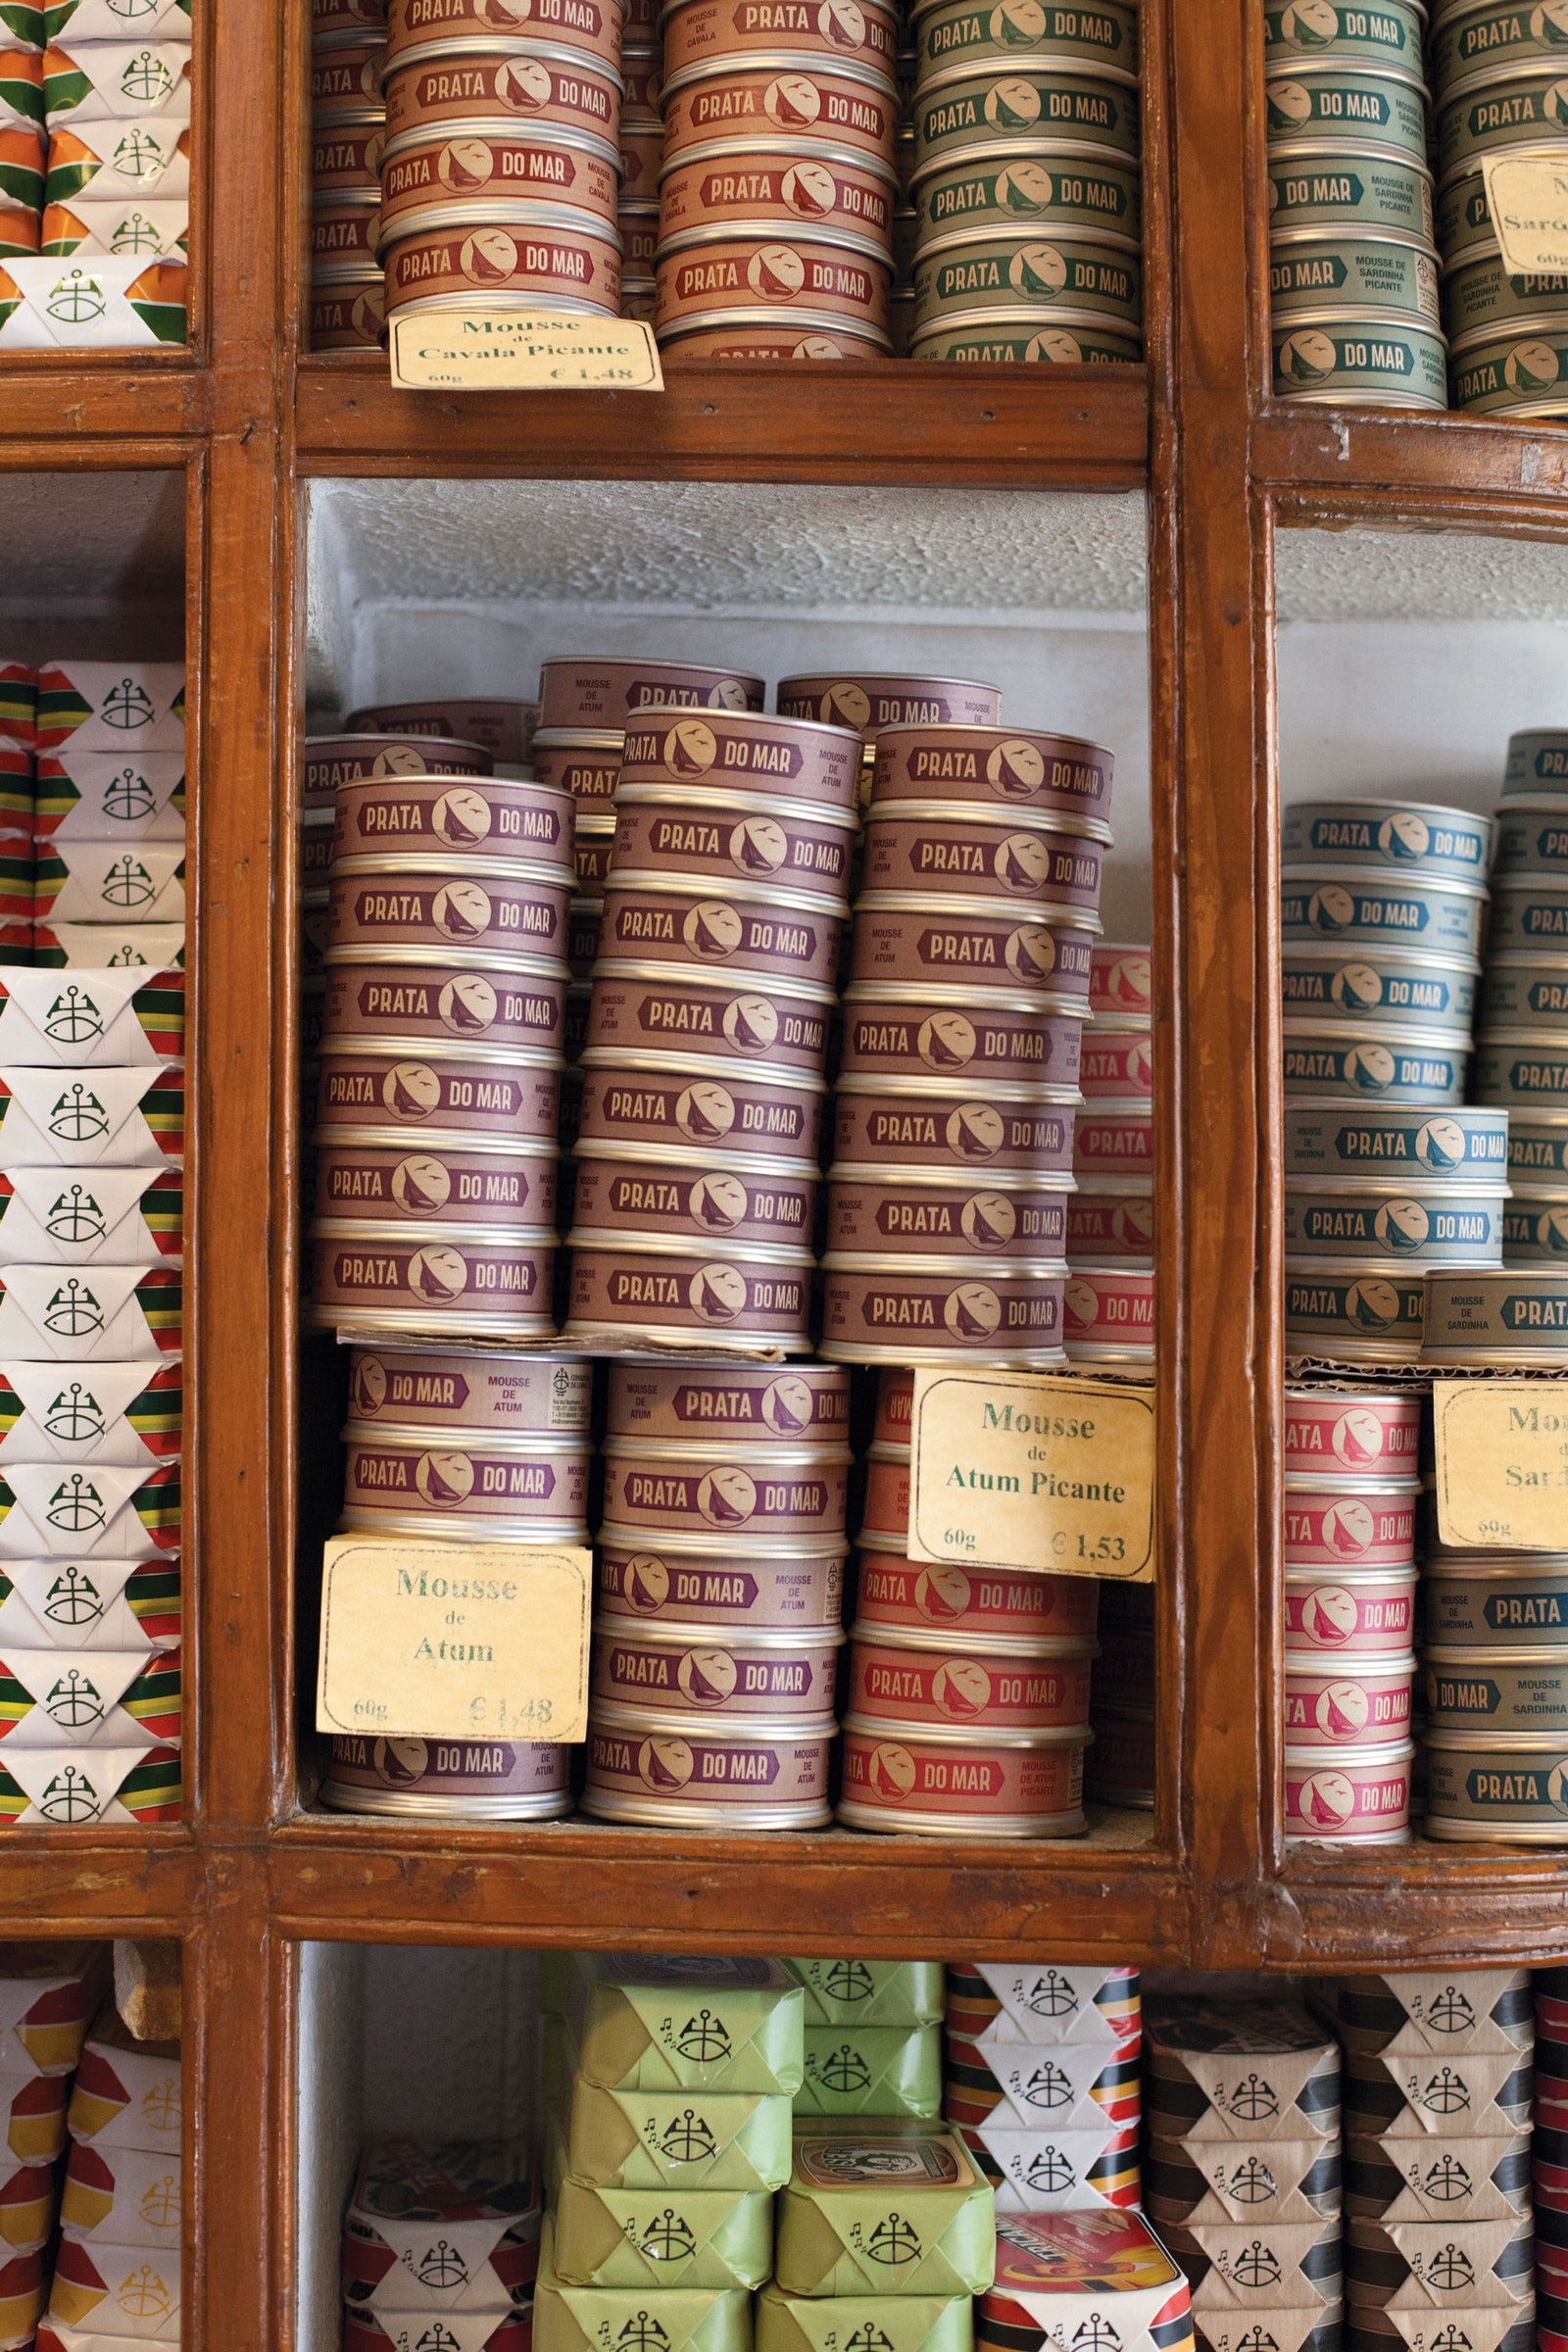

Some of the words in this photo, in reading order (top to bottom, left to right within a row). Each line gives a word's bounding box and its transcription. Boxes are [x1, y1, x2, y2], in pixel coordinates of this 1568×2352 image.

[413, 0, 465, 24] PRATA
[539, 0, 560, 20] DO
[564, 0, 593, 31] MAR
[687, 8, 717, 25] MOUSSE
[696, 23, 706, 33] DE
[1467, 18, 1521, 53] PRATA
[687, 31, 716, 48] CAVALA
[700, 90, 755, 121] PRATA
[829, 96, 848, 122] DO
[852, 105, 878, 133] MAR
[1320, 92, 1342, 116] DO
[1347, 94, 1380, 120] MAR
[1478, 97, 1535, 129] PRATA
[930, 101, 976, 136] PRATA
[1050, 94, 1070, 117] DO
[1076, 97, 1107, 123] MAR
[390, 160, 430, 194] PRATA
[502, 152, 524, 175] DO
[529, 155, 564, 181] MAR
[596, 177, 605, 188] DE
[1372, 176, 1403, 191] MOUSSE
[1375, 188, 1413, 205] SARDINHA
[1380, 200, 1411, 214] PICANTE
[1356, 256, 1394, 269] MOUSSE
[1396, 261, 1405, 270] DE
[684, 263, 738, 294] PRATA
[813, 265, 833, 290] DO
[837, 271, 864, 298] MAR
[946, 262, 1000, 293] PRATA
[1075, 264, 1095, 287] DO
[1100, 270, 1126, 297] MAR
[1359, 268, 1404, 281] SARDINHA
[1365, 280, 1401, 292] PICANTE
[463, 321, 581, 333] Mousse
[418, 348, 515, 359] Cavala
[528, 345, 629, 357] Picante
[1345, 343, 1365, 367] DO
[1372, 344, 1403, 370] MAR
[428, 374, 463, 384] 60g
[550, 368, 566, 379] €
[579, 368, 633, 380] 1,48
[575, 679, 611, 689] MOUSSE
[586, 691, 598, 700] DE
[579, 703, 603, 711] ATUM
[965, 702, 990, 713] MOUSSE
[819, 749, 847, 764] MOUSSE
[829, 764, 838, 774] DE
[917, 753, 977, 778] PRATA
[1053, 762, 1070, 788] DO
[1074, 766, 1098, 795] MAR
[821, 776, 841, 788] ATUM
[660, 824, 719, 853] PRATA
[794, 841, 813, 866] DO
[815, 845, 839, 873] MAR
[365, 896, 422, 920] PRATA
[499, 903, 518, 927] DO
[522, 906, 550, 933] MAR
[1361, 902, 1381, 922] DO
[1385, 902, 1419, 927] MAR
[872, 929, 902, 938] MOUSSE
[881, 941, 890, 950] DE
[874, 954, 895, 962] ATUM
[1287, 1054, 1336, 1078] PRATA
[1401, 1060, 1420, 1082] DO
[1423, 1062, 1447, 1087] MAR
[330, 1078, 373, 1102] PRATA
[450, 1081, 471, 1105] DO
[476, 1084, 511, 1109] MAR
[611, 1093, 665, 1120] PRATA
[743, 1104, 763, 1129] DO
[766, 1108, 797, 1134] MAR
[877, 1117, 936, 1142] PRATA
[1011, 1122, 1029, 1147] DO
[1034, 1123, 1058, 1149] MAR
[342, 1258, 398, 1285] PRATA
[475, 1263, 495, 1288] DO
[500, 1266, 528, 1291] MAR
[618, 1276, 679, 1302] PRATA
[754, 1284, 772, 1307] DO
[775, 1286, 798, 1310] MAR
[1451, 1296, 1485, 1305] MOUSSE
[1293, 1290, 1337, 1313] PRATA
[1462, 1308, 1471, 1317] DE
[1447, 1321, 1489, 1330] SARDINHA
[393, 1376, 412, 1400] DO
[416, 1377, 454, 1403] MAR
[488, 1376, 530, 1388] MOUSSE
[503, 1390, 515, 1399] DE
[627, 1385, 658, 1395] MOUSSE
[493, 1401, 522, 1412] ATUM
[636, 1396, 645, 1406] DE
[630, 1409, 651, 1419] ATUM
[982, 1402, 1096, 1440] Mousse
[1389, 1428, 1401, 1450] DO
[1028, 1446, 1047, 1461] de
[360, 1459, 407, 1488] PRATA
[483, 1467, 506, 1492] DO
[511, 1468, 544, 1494] MAR
[947, 1465, 1019, 1493] Atum
[1031, 1472, 1125, 1503] Picante
[1478, 1521, 1511, 1535] 60g
[944, 1528, 976, 1550] 60g
[1052, 1531, 1067, 1555] €
[1076, 1534, 1125, 1561] 1,53
[396, 1570, 517, 1599] Mousse
[776, 1575, 811, 1585] MOUSSE
[677, 1574, 701, 1599] DO
[705, 1576, 744, 1603] MAR
[788, 1588, 800, 1597] DE
[867, 1575, 906, 1601] PRATA
[980, 1585, 1003, 1608] DO
[1006, 1585, 1043, 1611] MAR
[781, 1600, 805, 1610] ATUM
[1449, 1607, 1458, 1616] DE
[1495, 1598, 1561, 1624] PRATA
[445, 1611, 466, 1625] de
[1365, 1605, 1382, 1628] DO
[1386, 1603, 1405, 1627] MAR
[414, 1637, 494, 1661] Atum
[616, 1654, 667, 1684] PRATA
[746, 1665, 767, 1690] DO
[771, 1667, 803, 1691] MAR
[1518, 1680, 1561, 1690] MOUSSE
[1533, 1692, 1546, 1701] DE
[354, 1699, 387, 1721] 60g
[471, 1696, 486, 1721] €
[498, 1697, 553, 1727] 1,48
[1513, 1705, 1567, 1715] SARDINHA
[541, 1754, 550, 1763] DE
[794, 1748, 819, 1759] MOUSSE
[535, 1766, 554, 1776] ATUM
[804, 1761, 811, 1771] DE
[798, 1774, 815, 1784] ATUM
[924, 1765, 947, 1788] DO
[952, 1765, 990, 1790] MAR
[1020, 1774, 1031, 1784] DE
[1477, 1775, 1539, 1800] PRATA
